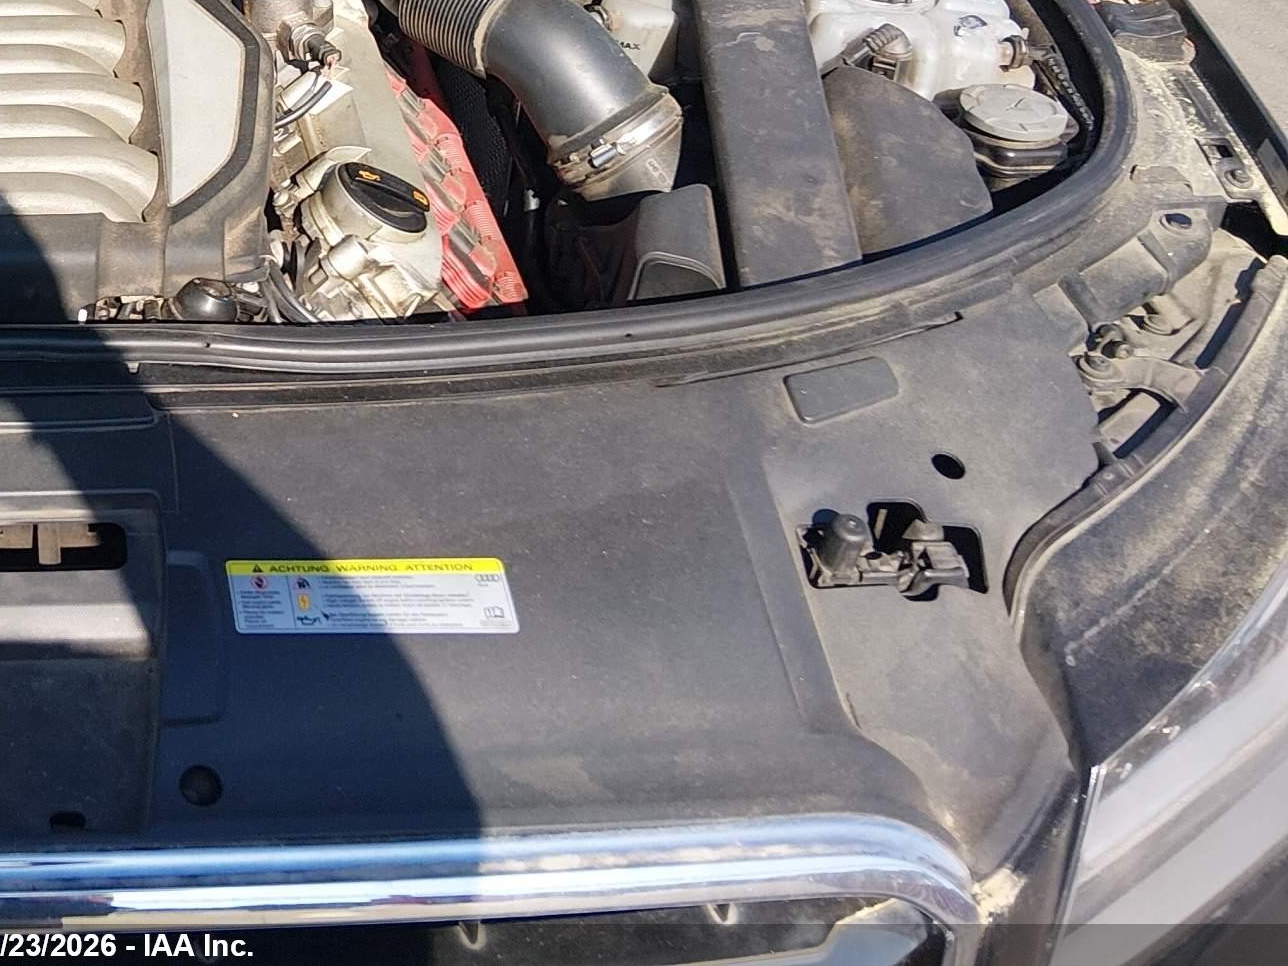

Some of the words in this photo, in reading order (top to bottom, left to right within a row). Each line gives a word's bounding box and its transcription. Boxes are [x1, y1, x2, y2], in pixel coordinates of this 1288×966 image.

[268, 564, 330, 573] ACHTUNG
[335, 563, 398, 572] WARNING
[403, 562, 473, 572] ATTENTION
